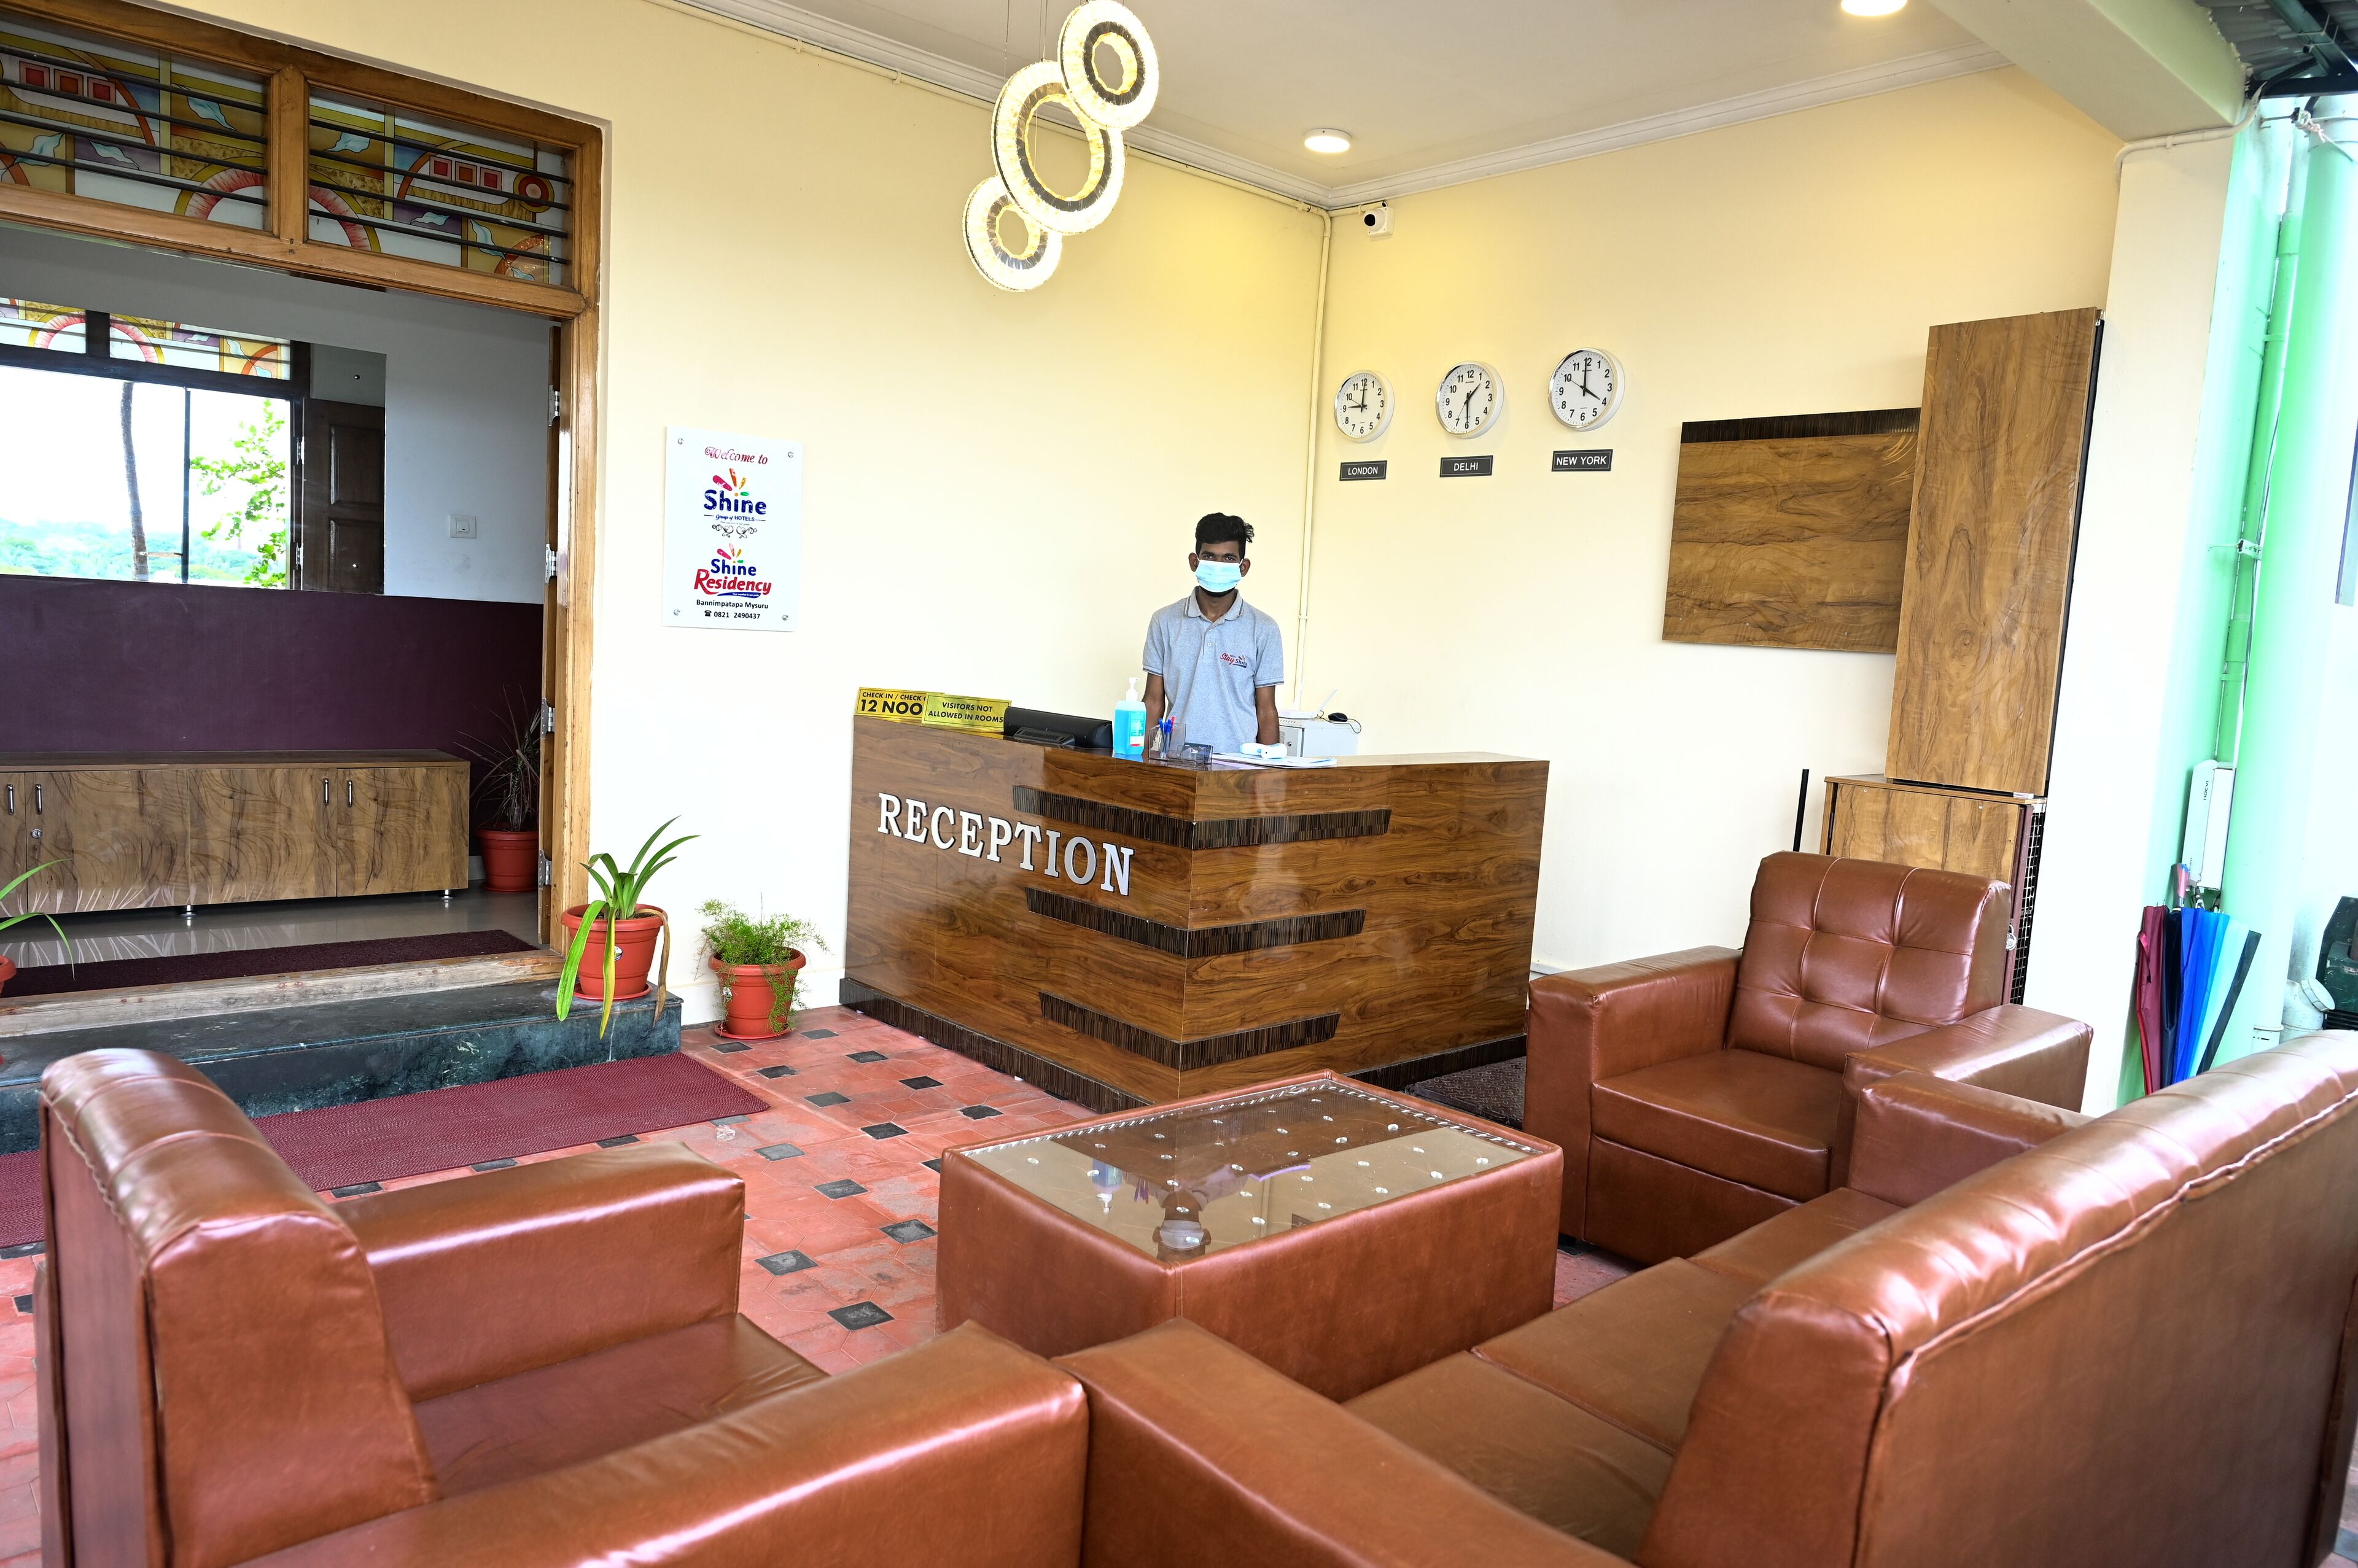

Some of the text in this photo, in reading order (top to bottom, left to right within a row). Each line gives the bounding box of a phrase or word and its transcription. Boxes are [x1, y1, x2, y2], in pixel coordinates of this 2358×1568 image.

[1573, 362, 1579, 371] 11
[1597, 360, 1601, 369] 1
[1467, 370, 1474, 378] 12
[1563, 373, 1572, 382] 10
[1605, 369, 1609, 378] 2
[1457, 375, 1463, 383] 11
[1558, 387, 1564, 395] 9
[1607, 383, 1613, 392] 3
[1561, 400, 1566, 409] 8
[1601, 397, 1606, 406] 4
[1570, 409, 1574, 418] 7
[1580, 413, 1586, 421] 6
[1592, 408, 1597, 417] 5
[1455, 418, 1460, 427] 7
[705, 446, 768, 464] Welcome to
[1557, 456, 1607, 465] NEW YORK
[1348, 466, 1378, 475] LONDON
[1453, 462, 1478, 472] DELHI
[704, 489, 766, 514] Shine
[710, 559, 757, 576] Shine
[694, 569, 772, 595] Residency
[696, 599, 743, 608] Bannimpatapa
[1220, 653, 1235, 665] Stay
[861, 699, 923, 715] 12 NOO
[942, 702, 975, 711] VISITORS
[928, 710, 962, 720] ALLOWED
[877, 793, 1134, 896] RECEPTION
